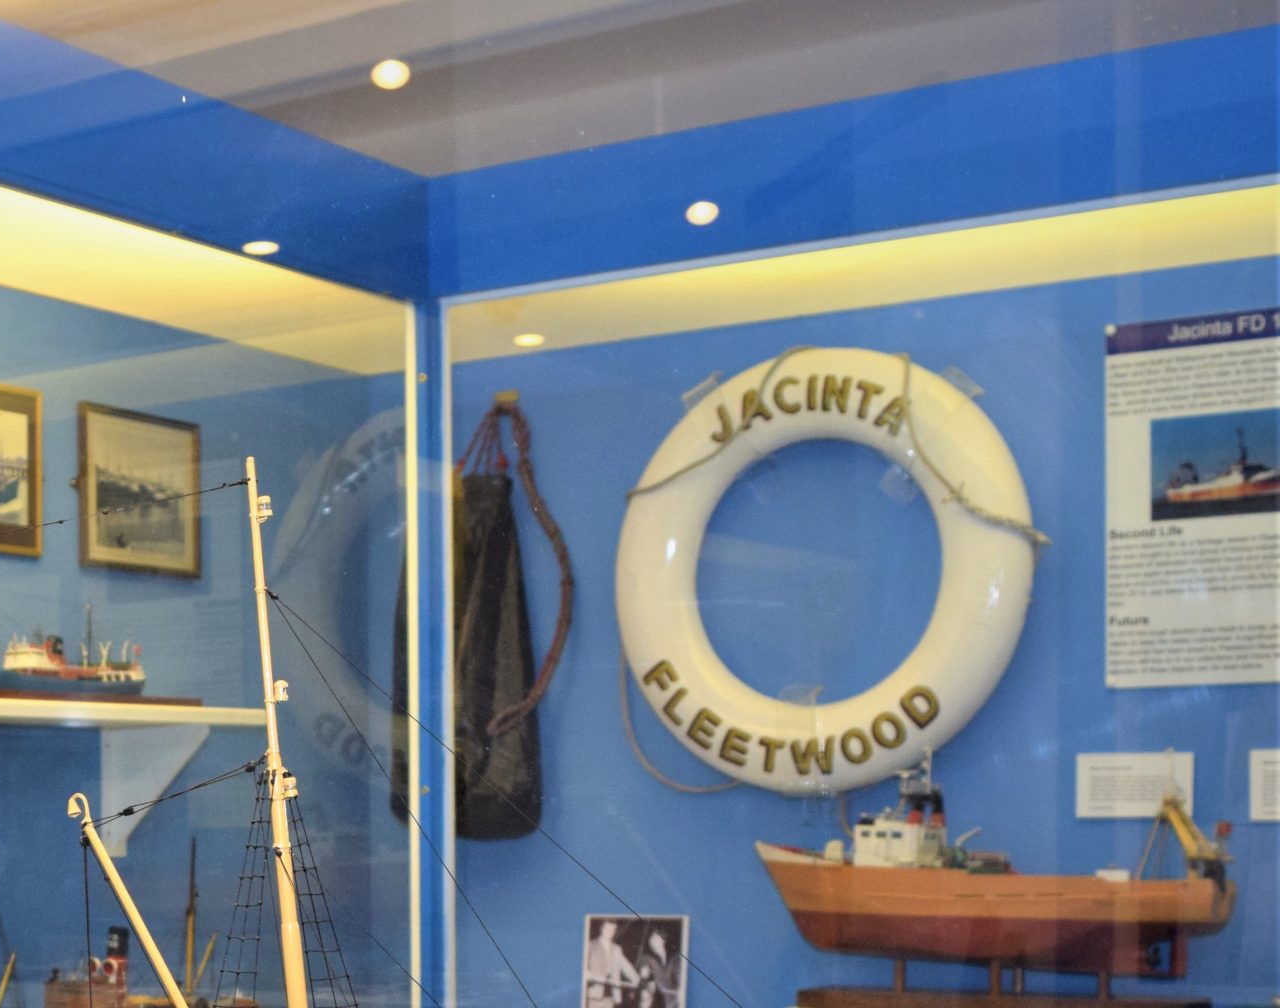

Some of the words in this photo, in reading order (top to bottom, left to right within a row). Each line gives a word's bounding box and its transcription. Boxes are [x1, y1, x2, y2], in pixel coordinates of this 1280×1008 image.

[1168, 324, 1233, 343] Jacinta
[1237, 314, 1266, 334] FD
[710, 374, 911, 444] JACINTA
[1109, 528, 1156, 540] Second
[1159, 525, 1183, 536] Life
[1109, 614, 1149, 626] Future
[642, 659, 939, 775] FLEETWOOD
